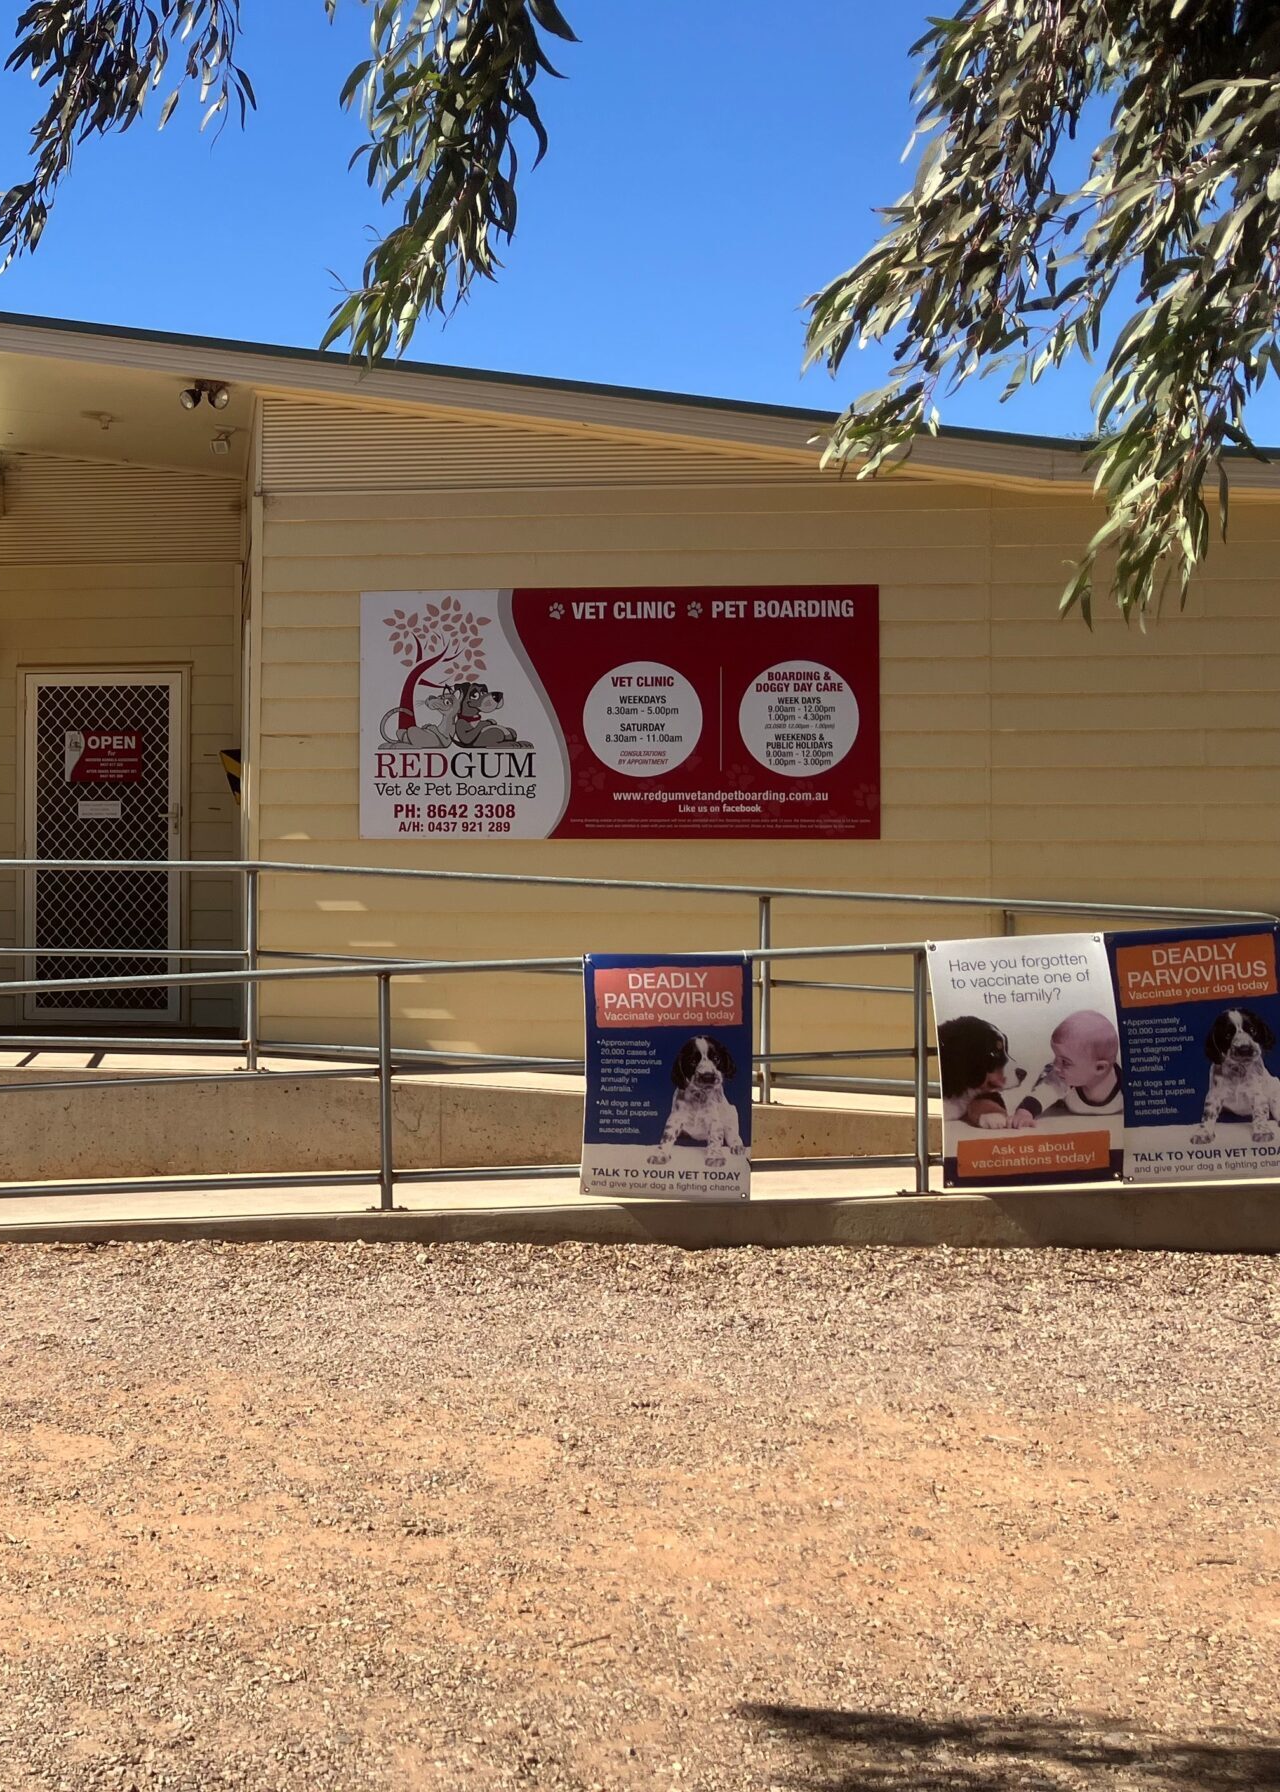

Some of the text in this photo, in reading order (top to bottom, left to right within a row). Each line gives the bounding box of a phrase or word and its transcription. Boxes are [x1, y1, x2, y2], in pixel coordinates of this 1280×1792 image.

[572, 601, 676, 619] VET CLINIC
[712, 599, 855, 618] PET BOARDING
[768, 671, 831, 681] BOARDING &
[611, 676, 674, 688] VET CLINIC
[756, 682, 844, 692] DOGGY DAY CARE
[619, 695, 667, 704] WEEKDAYS
[607, 706, 638, 715] 8.30am
[647, 706, 679, 716] 5.00pm
[768, 705, 796, 713] 9.00am
[804, 705, 836, 714] 12.00pm
[768, 714, 796, 722] 1.00pm
[803, 713, 831, 721] 4.30pm
[620, 723, 666, 732] SATURDAY
[87, 736, 136, 749] OPEN
[605, 734, 637, 743] 8.30am
[646, 734, 683, 743] 11.00am
[766, 750, 794, 758] 9.00am
[802, 750, 834, 759] 12.00pm
[374, 752, 537, 778] REDGUM
[768, 759, 796, 767] 1.00pm
[803, 758, 831, 767] 3.00pm
[374, 782, 537, 798] Vet & Pet Boarding
[613, 790, 829, 803] www.redgumvetandpetboarding.com.au
[394, 804, 515, 818] PH: 8642 3308
[678, 804, 696, 813] Like
[722, 804, 762, 812] facebook
[398, 821, 511, 832] A/H: 0437 921 289
[1152, 943, 1237, 966] DEADLY
[949, 954, 1087, 972] Have you forgotten
[951, 969, 1090, 989] to vaccinate one of
[1127, 960, 1267, 989] PARVOVIRUS
[628, 972, 708, 989] DEADLY
[984, 987, 1061, 1004] the family?
[1128, 980, 1269, 1000] Vaccinate your dog today
[604, 991, 734, 1008] PARVOVIRUS
[604, 1010, 735, 1022] Vaccinate your dog today
[1127, 1016, 1180, 1026] Approximately
[600, 1039, 651, 1048] Approximately
[1155, 1035, 1194, 1044] parvovirus
[1143, 1045, 1182, 1054] diagnosed
[625, 1058, 662, 1066] parvovirus
[1130, 1055, 1160, 1063] annually
[613, 1067, 650, 1075] diagnosed
[600, 1076, 630, 1084] annually
[1143, 1079, 1163, 1087] dogs
[1150, 1088, 1163, 1096] but
[1165, 1087, 1195, 1096] puppies
[610, 1099, 629, 1108] dogs
[1147, 1097, 1167, 1105] most
[991, 1141, 1075, 1155] Ask us about
[972, 1152, 1096, 1169] vaccinations today!
[1133, 1152, 1164, 1162] TALK
[1166, 1151, 1183, 1161] TO
[1187, 1149, 1222, 1159] YOUR
[1225, 1148, 1247, 1158] VET
[1134, 1165, 1151, 1173] and
[1153, 1164, 1172, 1174] give
[1174, 1164, 1194, 1173] your
[1197, 1162, 1214, 1172] dog
[1225, 1160, 1258, 1170] fighting
[591, 1168, 741, 1181] TALK TO YOUR VET TODAY
[591, 1179, 607, 1187] and
[609, 1180, 627, 1189] give
[629, 1182, 647, 1190] your
[649, 1182, 666, 1191] dog
[676, 1182, 708, 1192] fighting
[709, 1184, 740, 1192] chance
